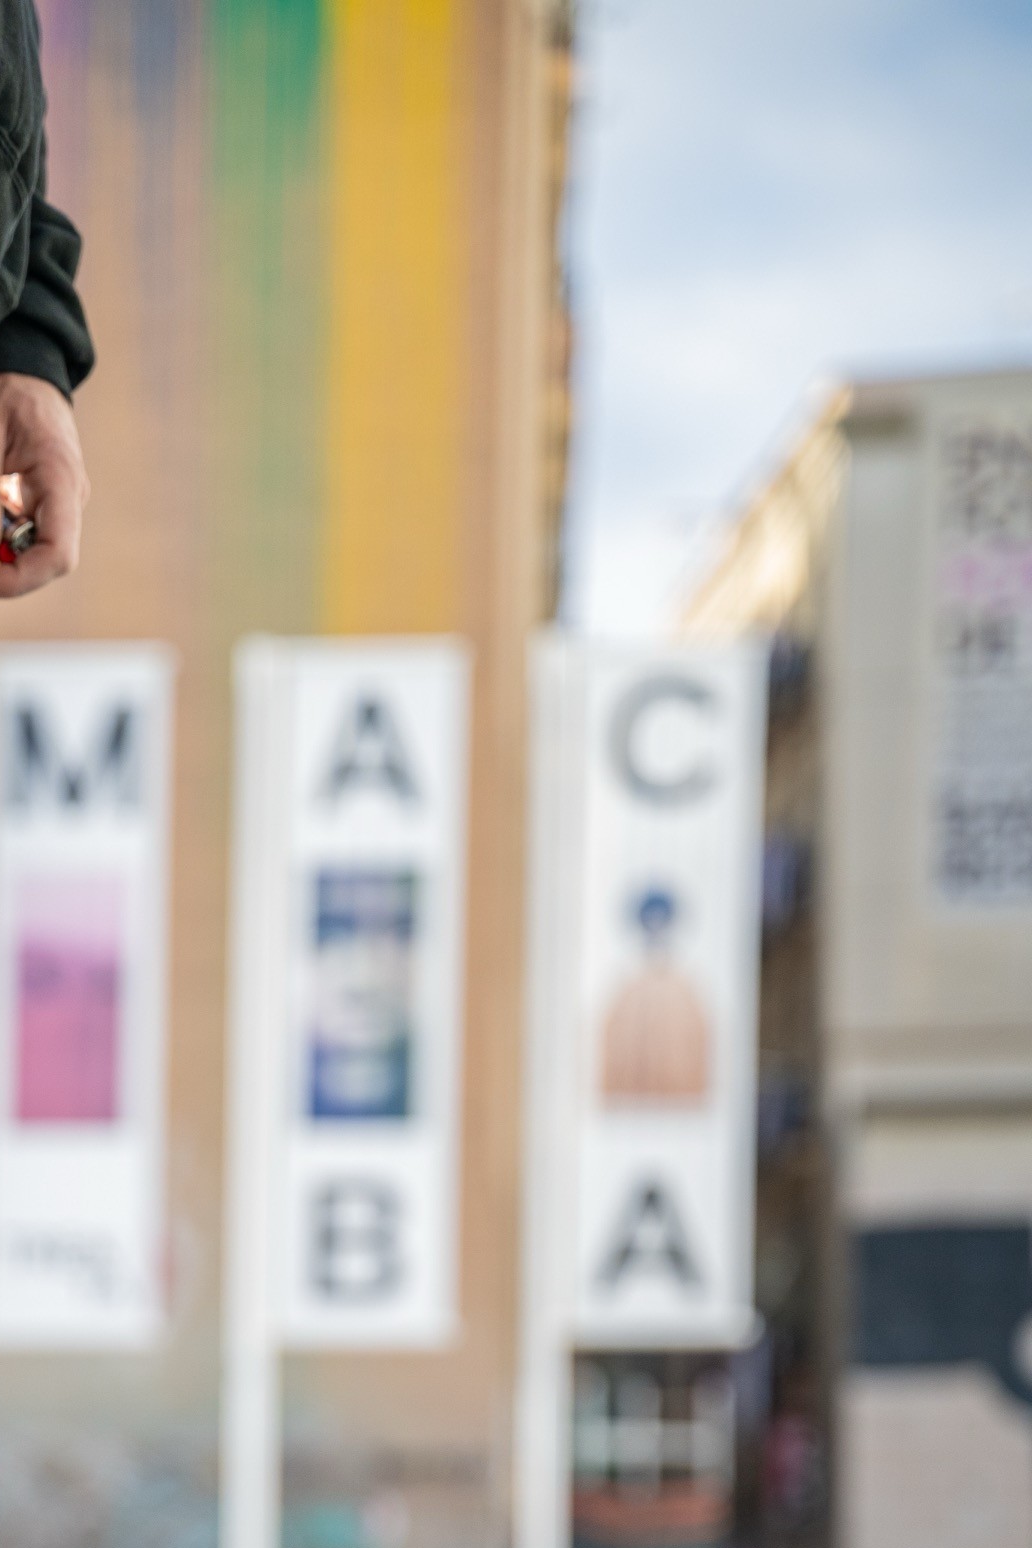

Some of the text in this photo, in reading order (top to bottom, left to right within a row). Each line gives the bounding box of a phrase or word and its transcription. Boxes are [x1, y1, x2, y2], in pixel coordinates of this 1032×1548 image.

[2, 696, 143, 818] M
[313, 695, 423, 816] A
[608, 673, 720, 809] C
[309, 1174, 405, 1299] B
[593, 1174, 706, 1292] A
